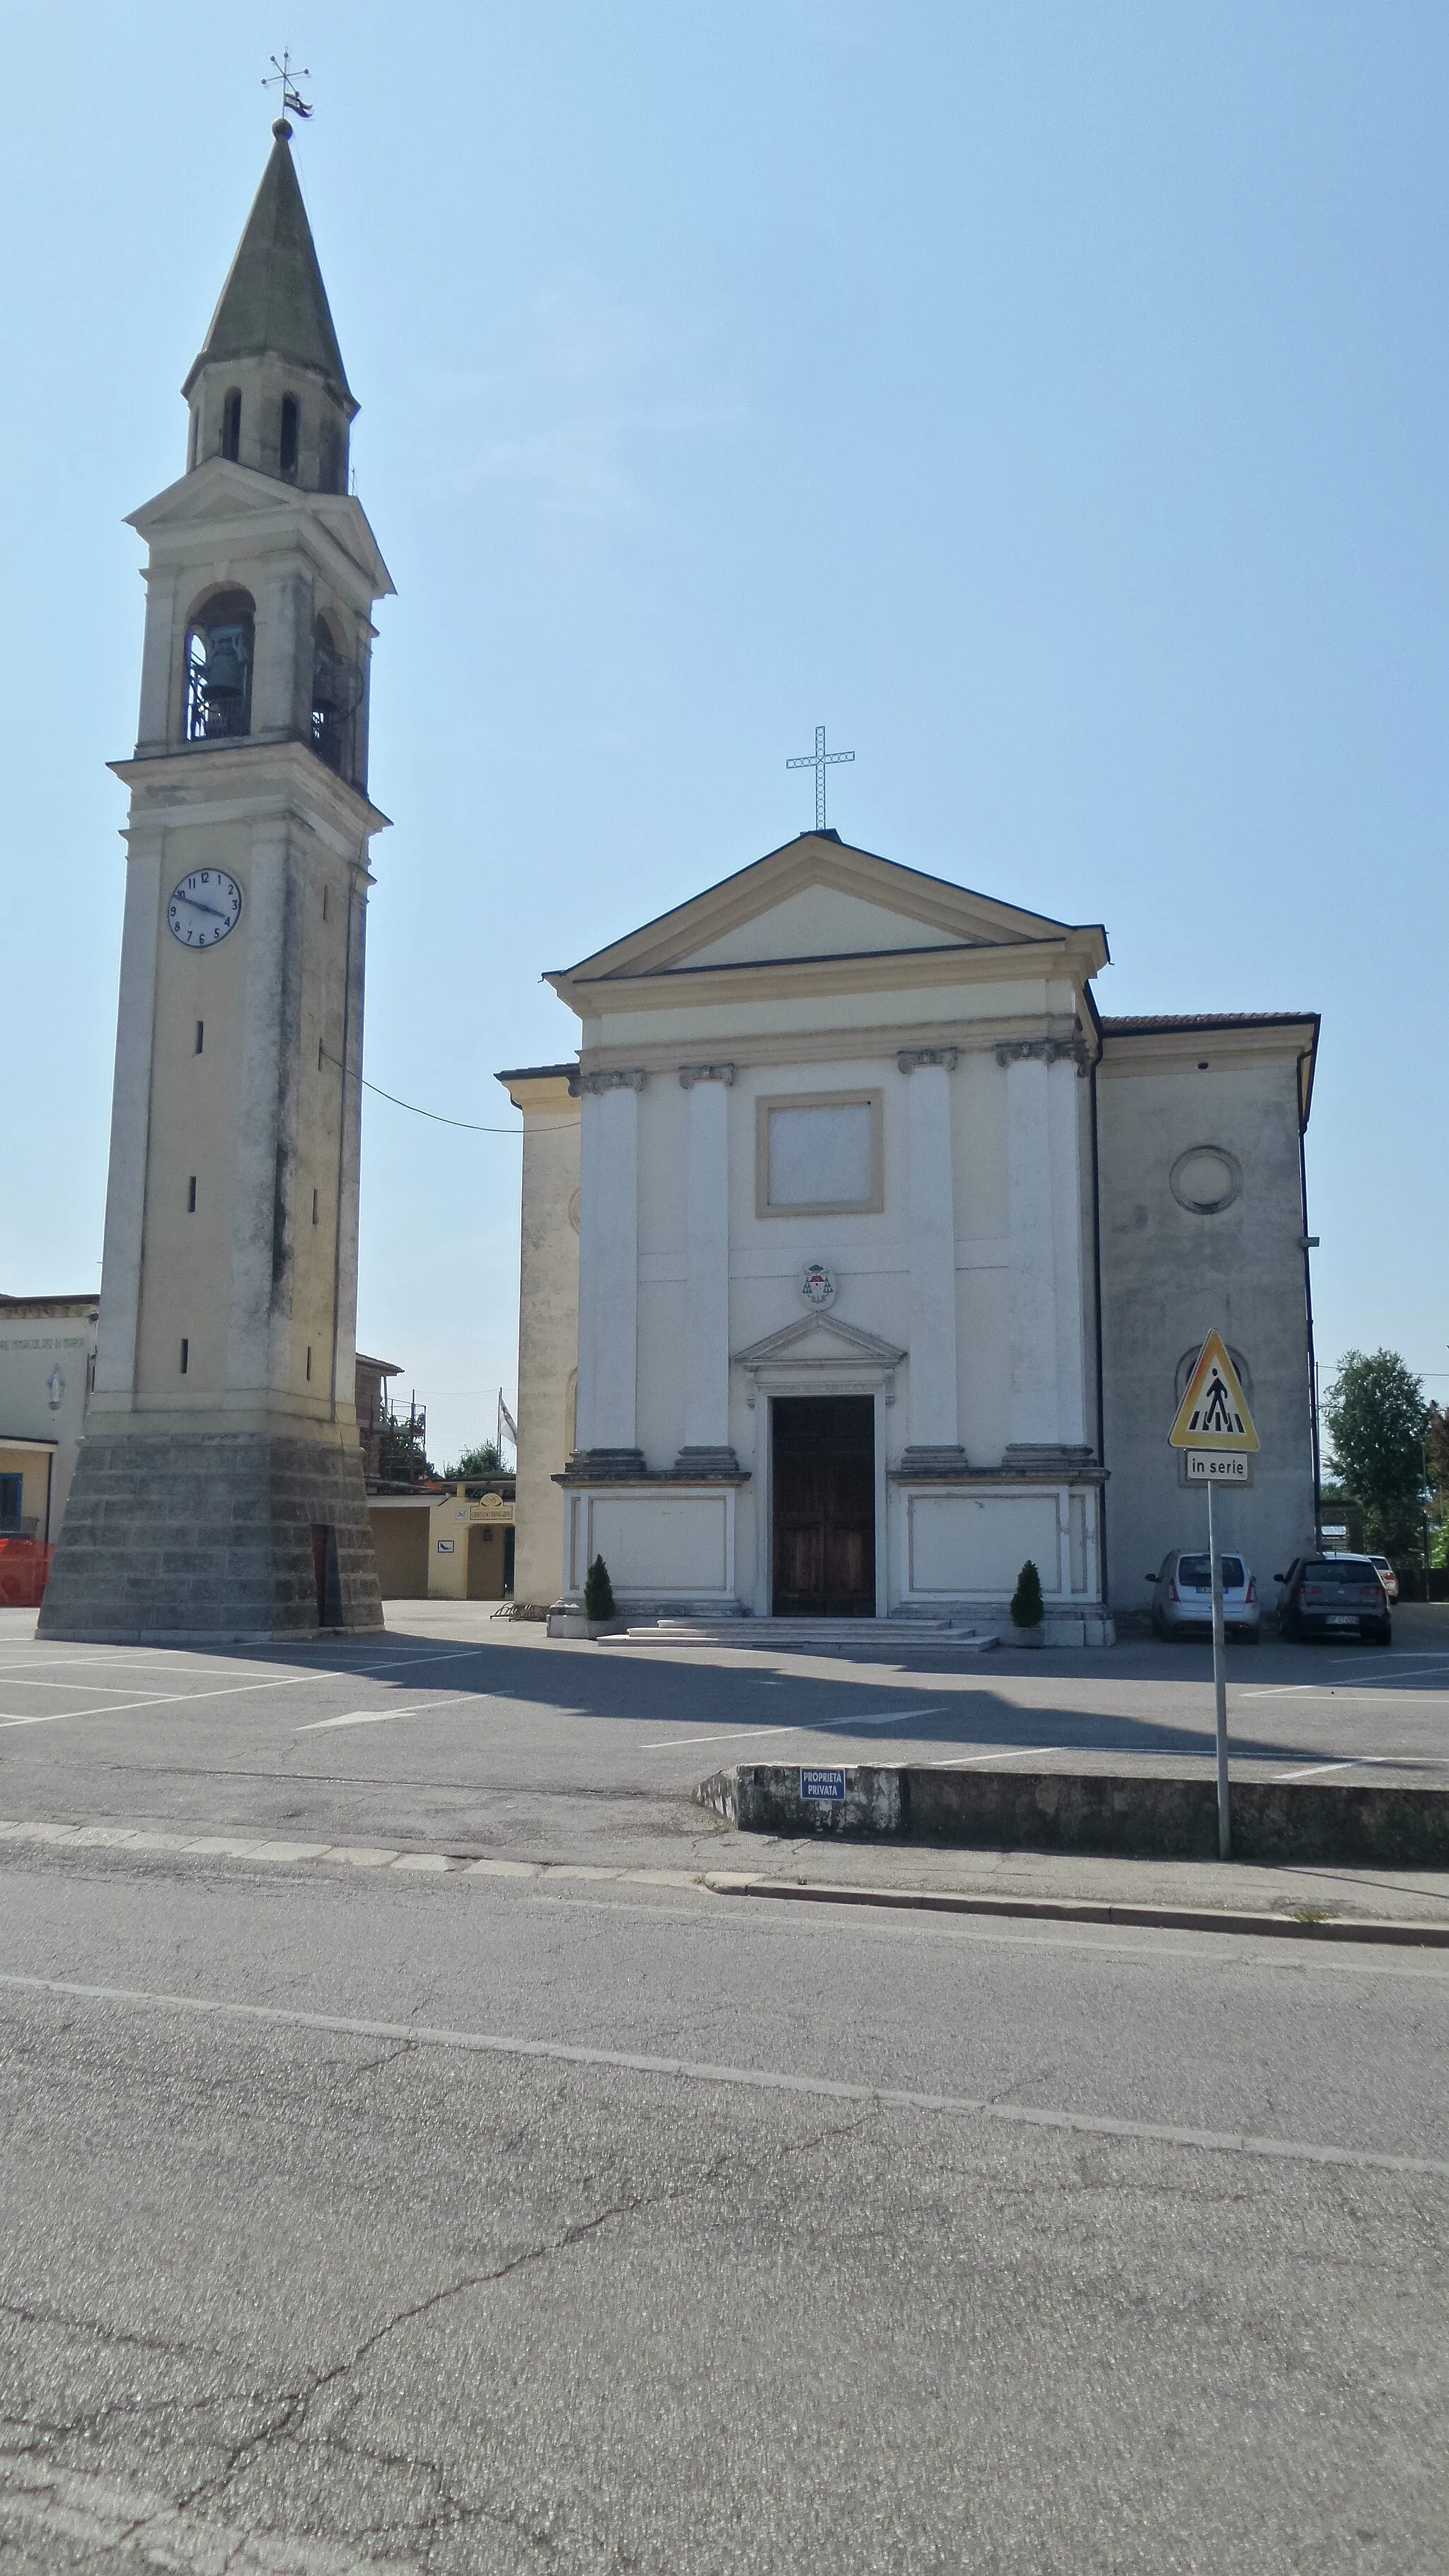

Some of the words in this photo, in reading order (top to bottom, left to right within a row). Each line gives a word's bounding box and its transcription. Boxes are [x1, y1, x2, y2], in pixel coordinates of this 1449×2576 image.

[188, 877, 195, 889] 11
[201, 872, 209, 883] 12
[218, 874, 221, 885] 1
[228, 884, 233, 895] 2
[232, 899, 237, 910] 3
[171, 906, 176, 916] 9
[175, 922, 180, 931] 8
[224, 916, 230, 927] 4
[187, 931, 192, 942] 7
[214, 928, 219, 938] 5
[199, 934, 204, 944] 6
[1192, 1458, 1204, 1472] in
[1210, 1460, 1243, 1474] serie
[804, 1771, 842, 1783] PROPRIETÀ
[808, 1785, 838, 1796] PRIVATA
